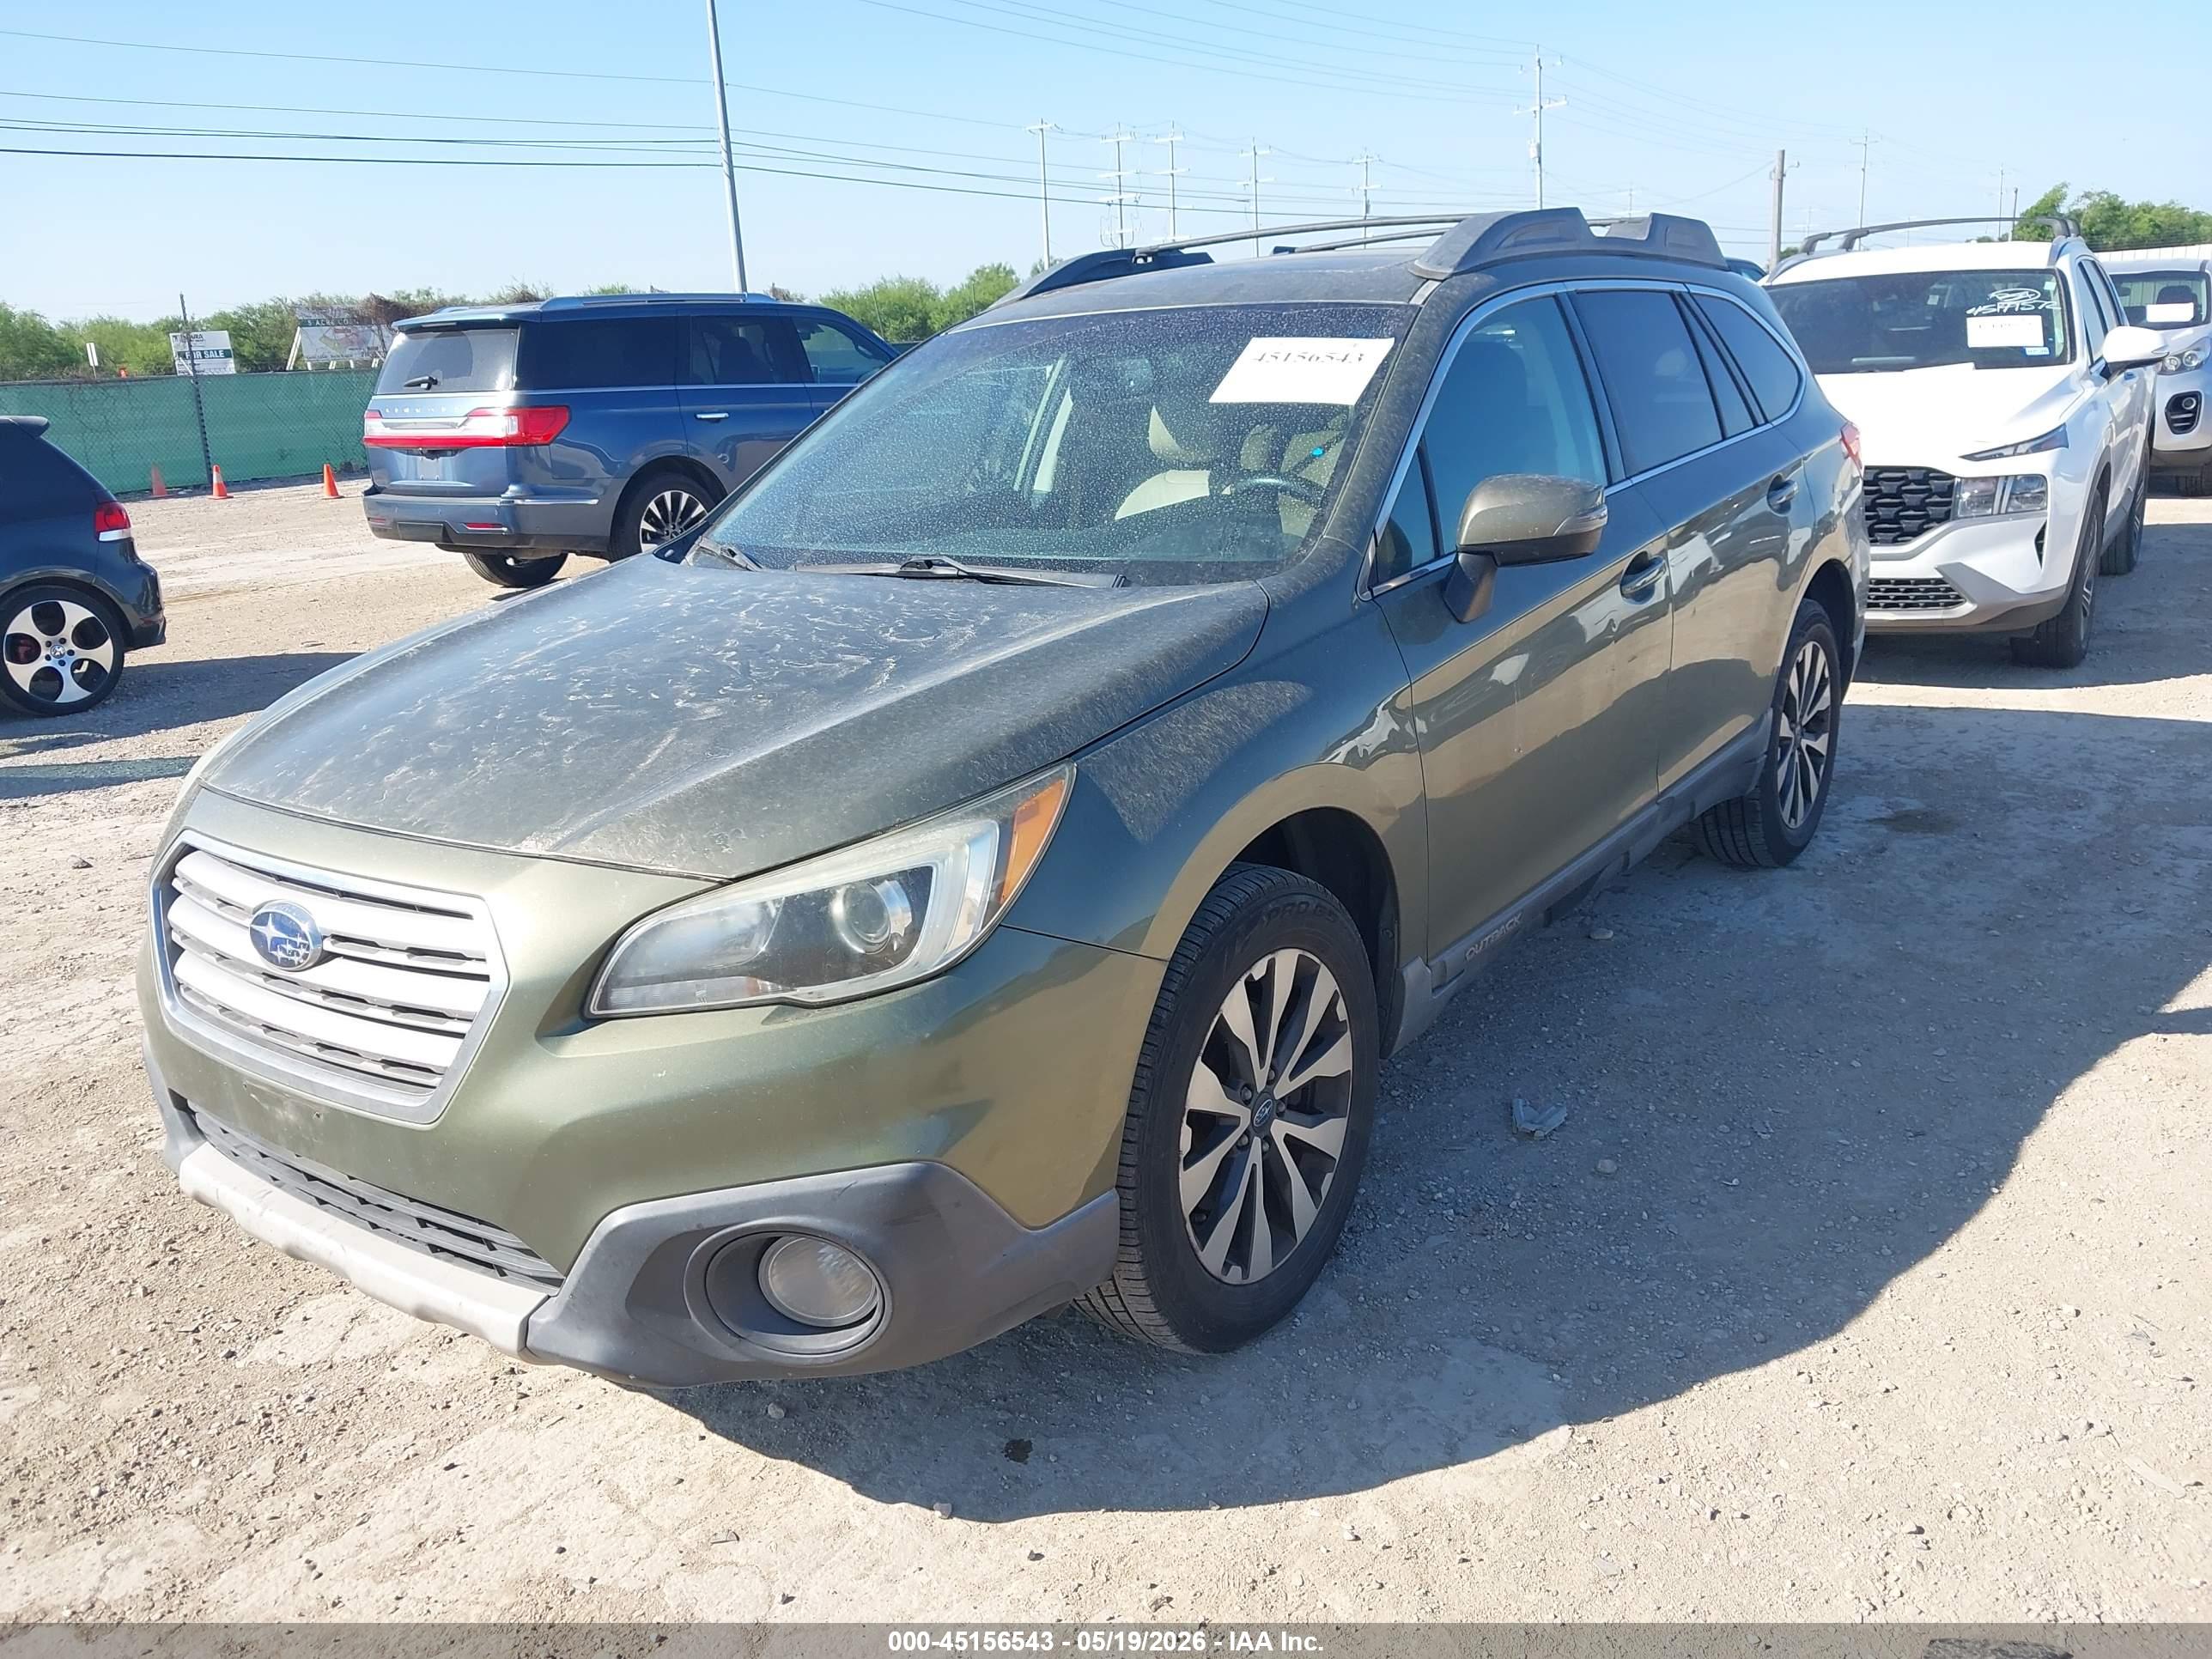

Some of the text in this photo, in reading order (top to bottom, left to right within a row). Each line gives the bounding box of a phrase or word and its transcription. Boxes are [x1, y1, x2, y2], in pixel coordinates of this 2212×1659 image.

[204, 349, 225, 359] SALE
[1251, 350, 1364, 363] 45156543
[1465, 912, 1522, 961] OUTBACK
